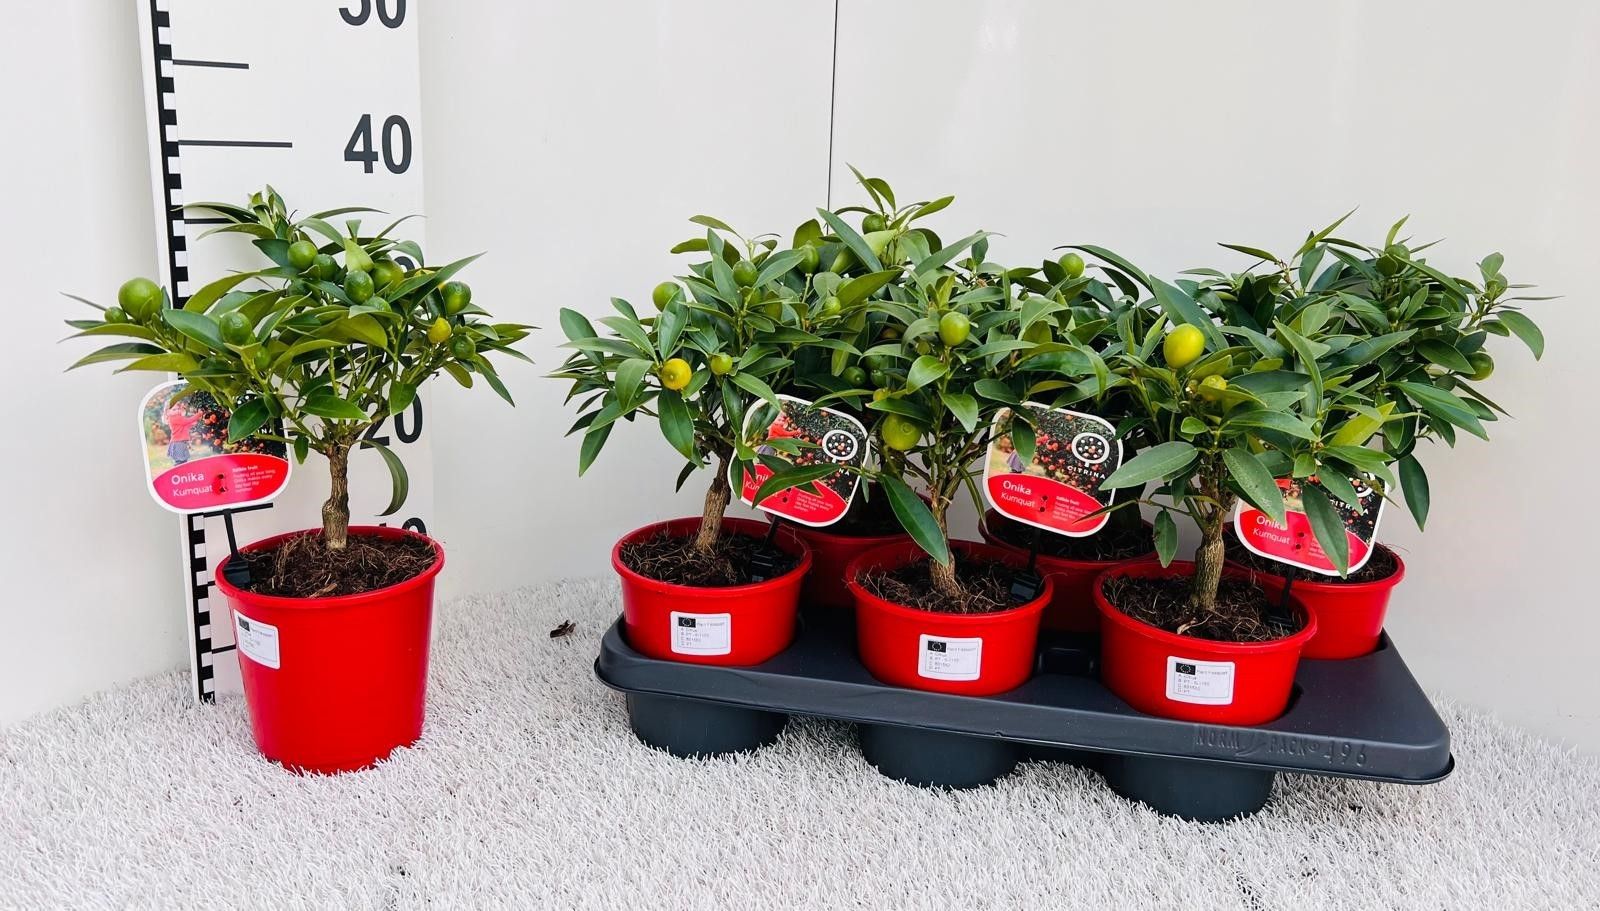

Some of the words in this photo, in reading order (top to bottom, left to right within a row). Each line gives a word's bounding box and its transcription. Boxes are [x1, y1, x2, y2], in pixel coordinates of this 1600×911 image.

[343, 113, 413, 175] 40
[171, 473, 205, 485] Onika
[1067, 465, 1106, 480] CITRINA
[172, 484, 213, 498] Kumquat
[1002, 480, 1032, 495] Onika
[1001, 491, 1036, 508] Kumquat
[1252, 528, 1291, 545] Kumquat
[1195, 723, 1240, 749] NORM
[1323, 739, 1367, 768] 496
